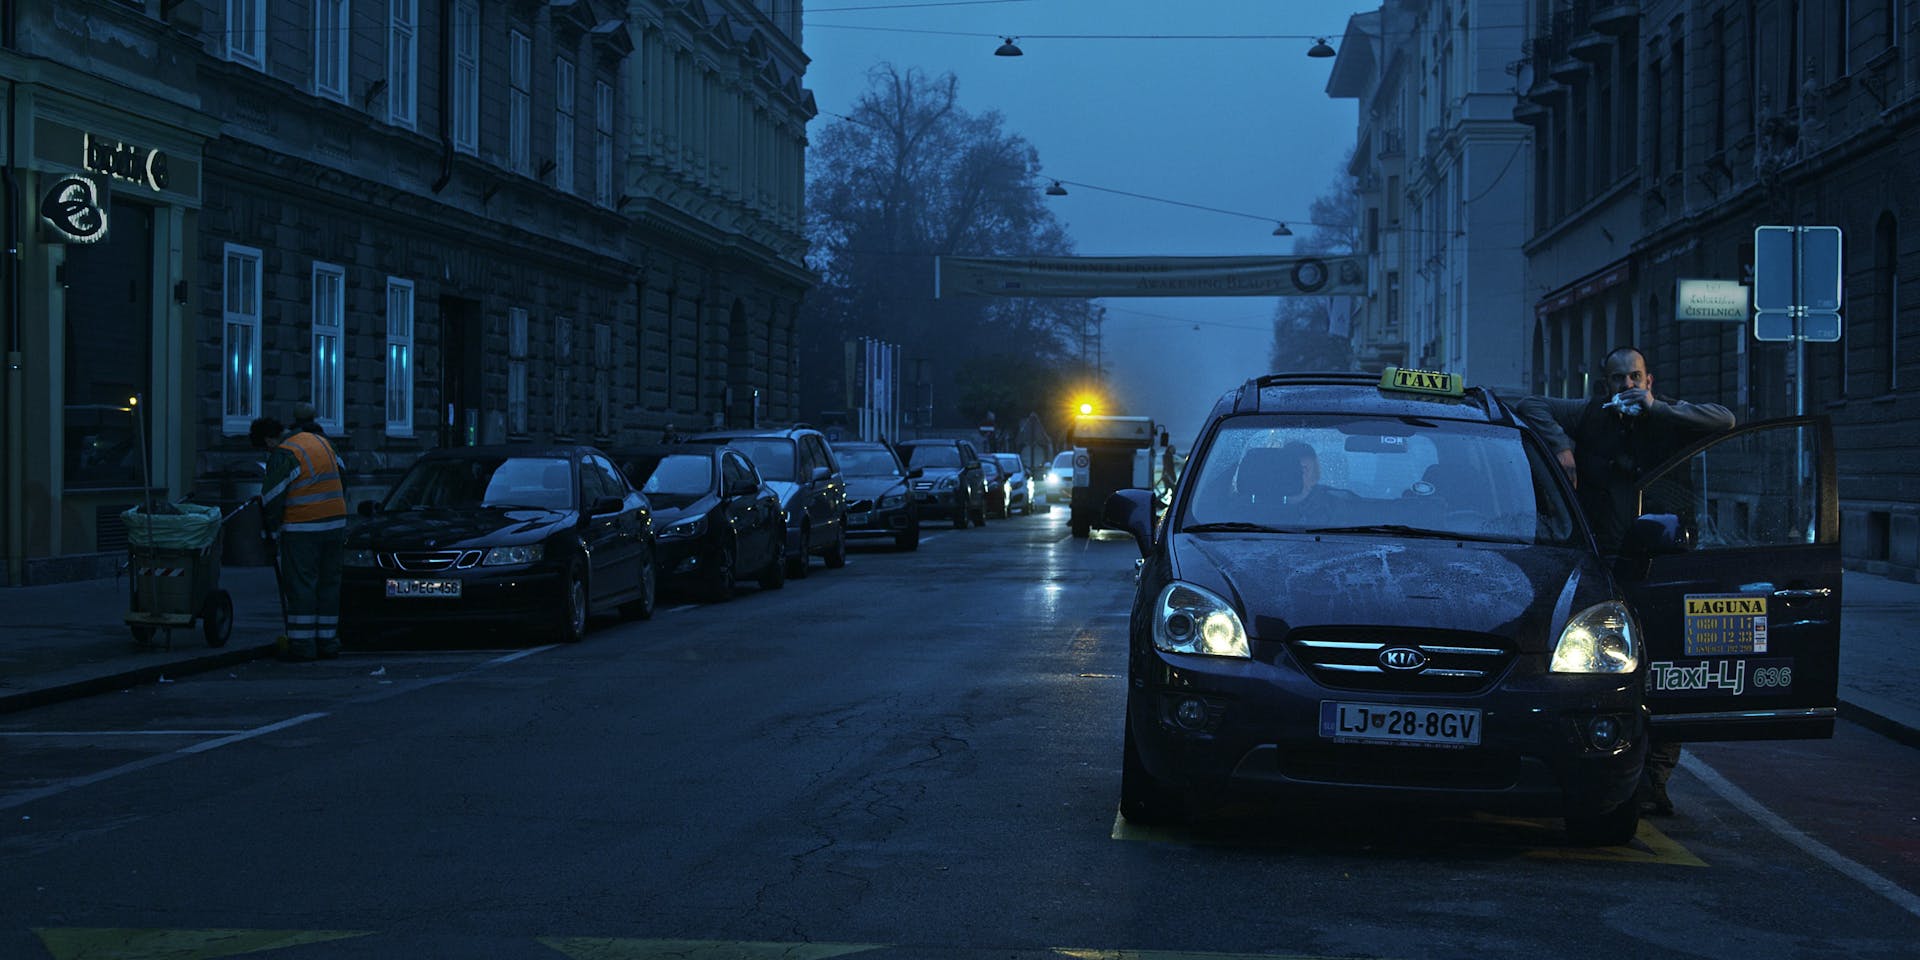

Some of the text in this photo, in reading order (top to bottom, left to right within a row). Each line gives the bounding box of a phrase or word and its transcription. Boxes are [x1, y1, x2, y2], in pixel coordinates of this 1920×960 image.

[1686, 306, 1742, 317] ČISTILNICA
[1398, 372, 1449, 390] TAXI
[397, 582, 411, 594] LJ
[1688, 600, 1763, 614] LAGUNA
[1387, 652, 1418, 665] KIA
[1651, 660, 1745, 696] Taxi-Lj
[1753, 667, 1792, 688] 636
[1340, 708, 1475, 738] LJ 28-8GV
